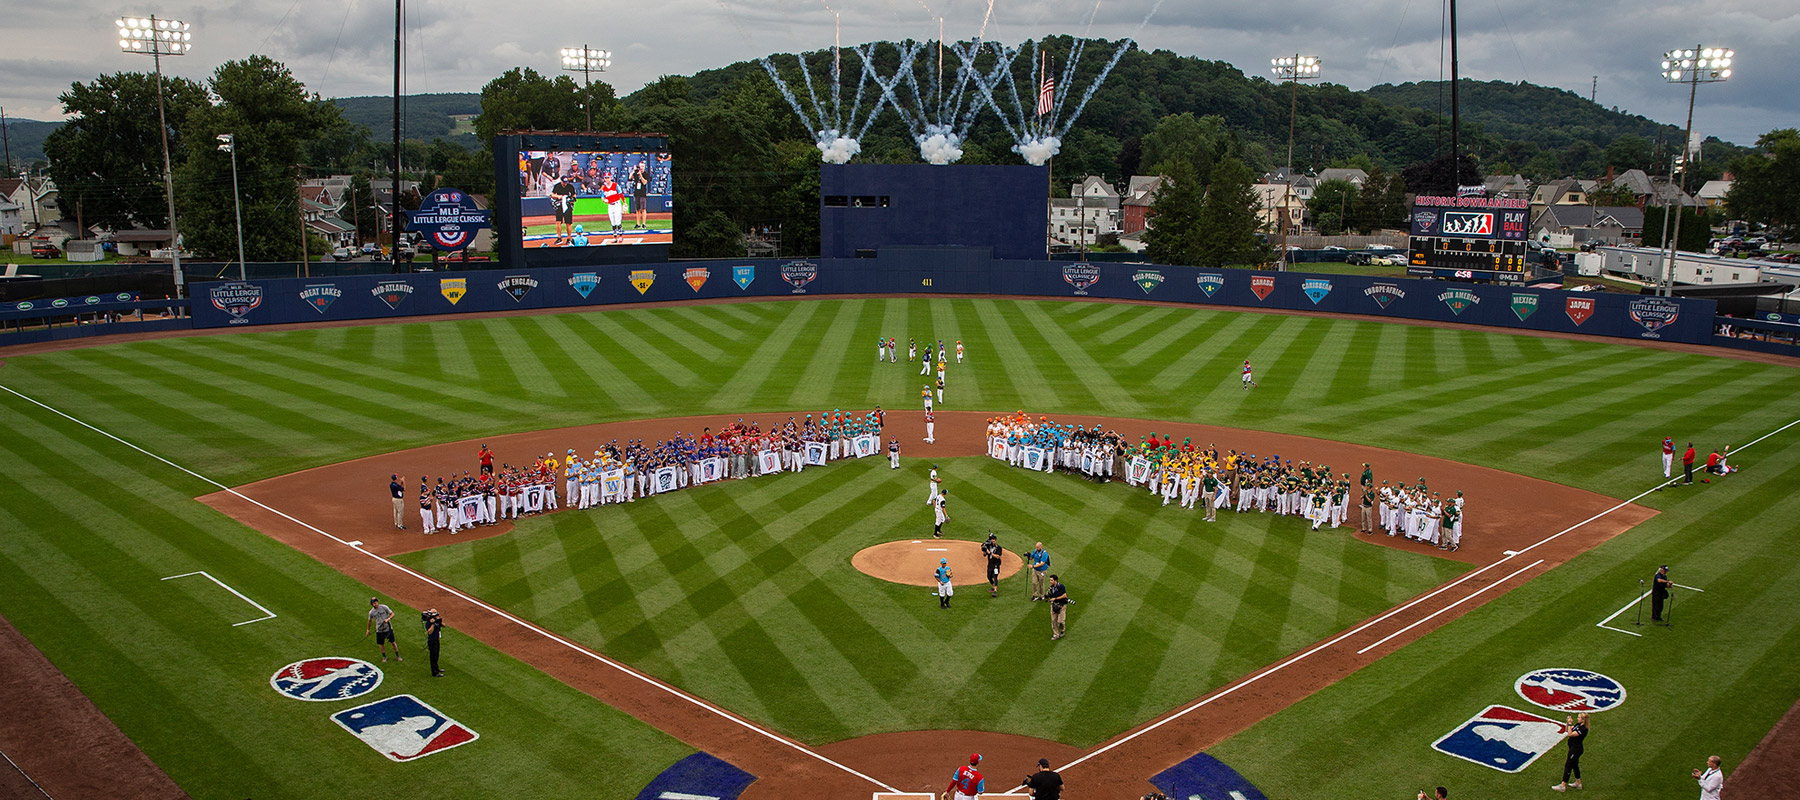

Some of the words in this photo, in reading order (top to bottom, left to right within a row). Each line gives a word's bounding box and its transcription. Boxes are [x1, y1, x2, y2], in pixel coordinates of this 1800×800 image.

[1416, 196, 1455, 207] HISTORIC
[1457, 197, 1501, 208] BOWMAN
[1503, 198, 1528, 209] FIELD
[413, 216, 434, 224] LITTLE
[435, 215, 459, 223] LEAGUE
[459, 215, 485, 223] CLASSIC
[1504, 213, 1525, 222] PLAY
[1503, 222, 1524, 231] BALL
[1442, 242, 1448, 250] 0
[1466, 243, 1471, 251] 0
[1489, 244, 1495, 252] 0
[497, 280, 511, 290] NEW
[512, 279, 538, 289] ENGLAND
[922, 278, 932, 286] 411
[1196, 276, 1224, 285] AUSTRALIA
[1252, 279, 1273, 287] CANADA
[234, 289, 260, 297] LEAGUE
[299, 288, 319, 300] GREAT
[321, 288, 342, 298] LAKES
[371, 283, 414, 296] MID-ATLANTIC
[1364, 286, 1406, 299] EUROPE-AFRICA
[317, 298, 325, 306] GL
[1438, 292, 1454, 302] LATIN
[1455, 291, 1480, 305] AMERICA
[1513, 297, 1537, 306] MEXICO
[1570, 301, 1590, 310] JAPAN
[1631, 304, 1652, 312] LITTLE
[1652, 304, 1676, 314] LEAGUE
[1576, 312, 1581, 320] J
[605, 480, 620, 492] W
[961, 778, 970, 790] 4
